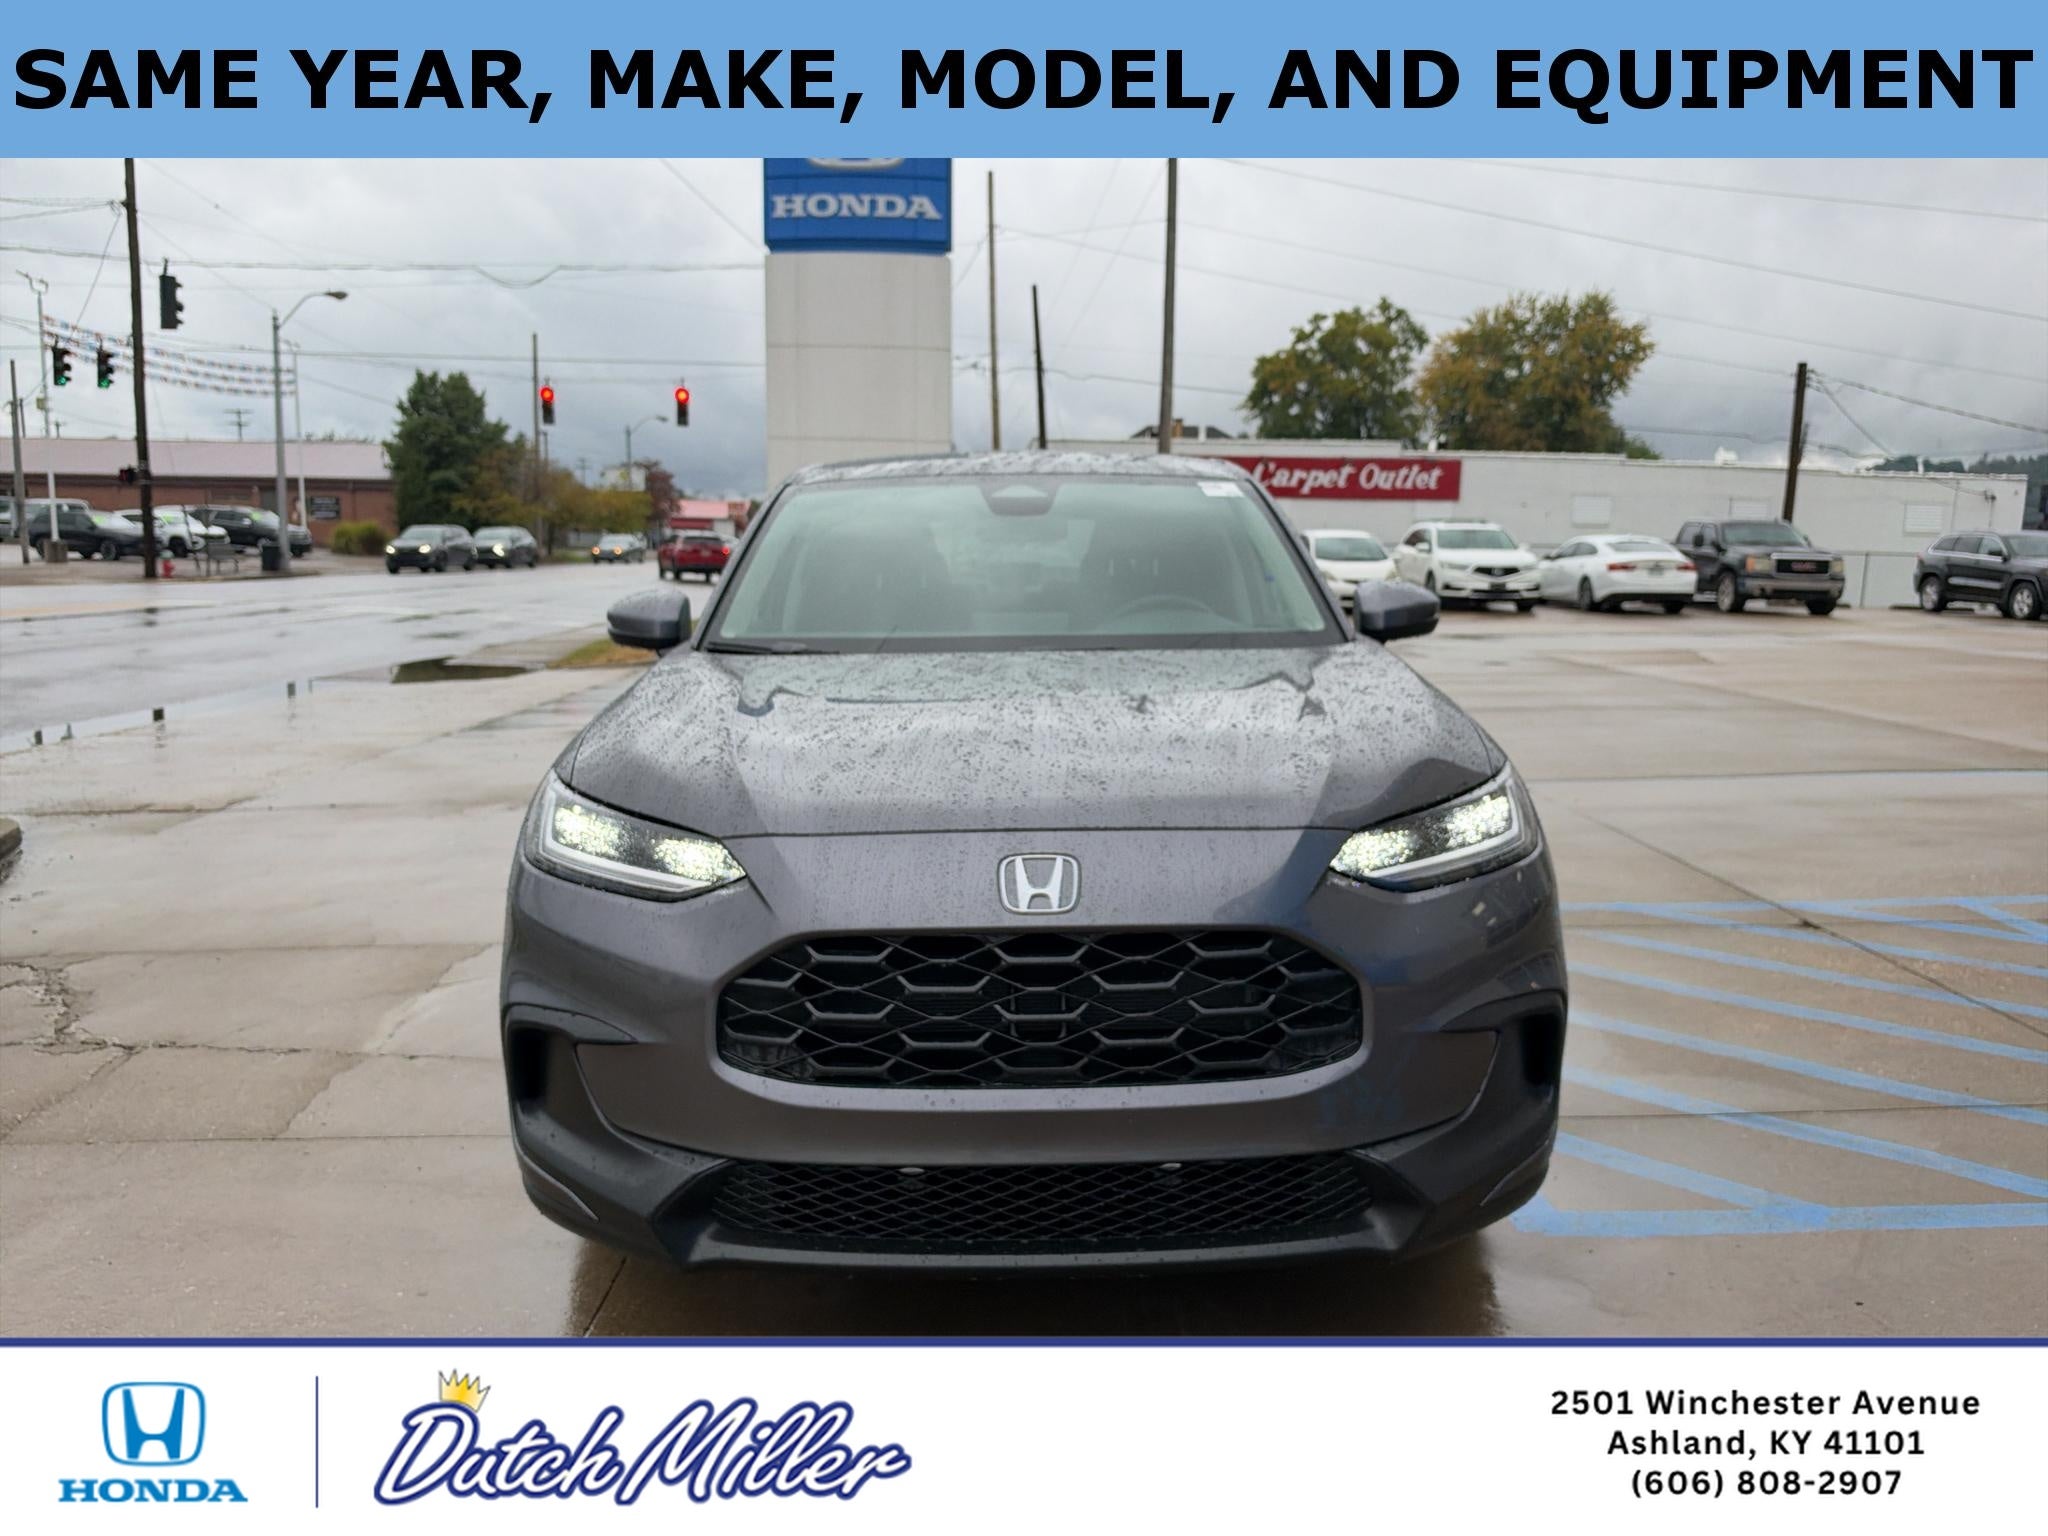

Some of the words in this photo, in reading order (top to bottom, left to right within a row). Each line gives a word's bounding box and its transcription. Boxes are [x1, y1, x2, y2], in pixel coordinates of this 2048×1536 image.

[771, 193, 942, 219] HONDA
[1252, 463, 1355, 495] Carpet
[1359, 463, 1443, 490] Outlet
